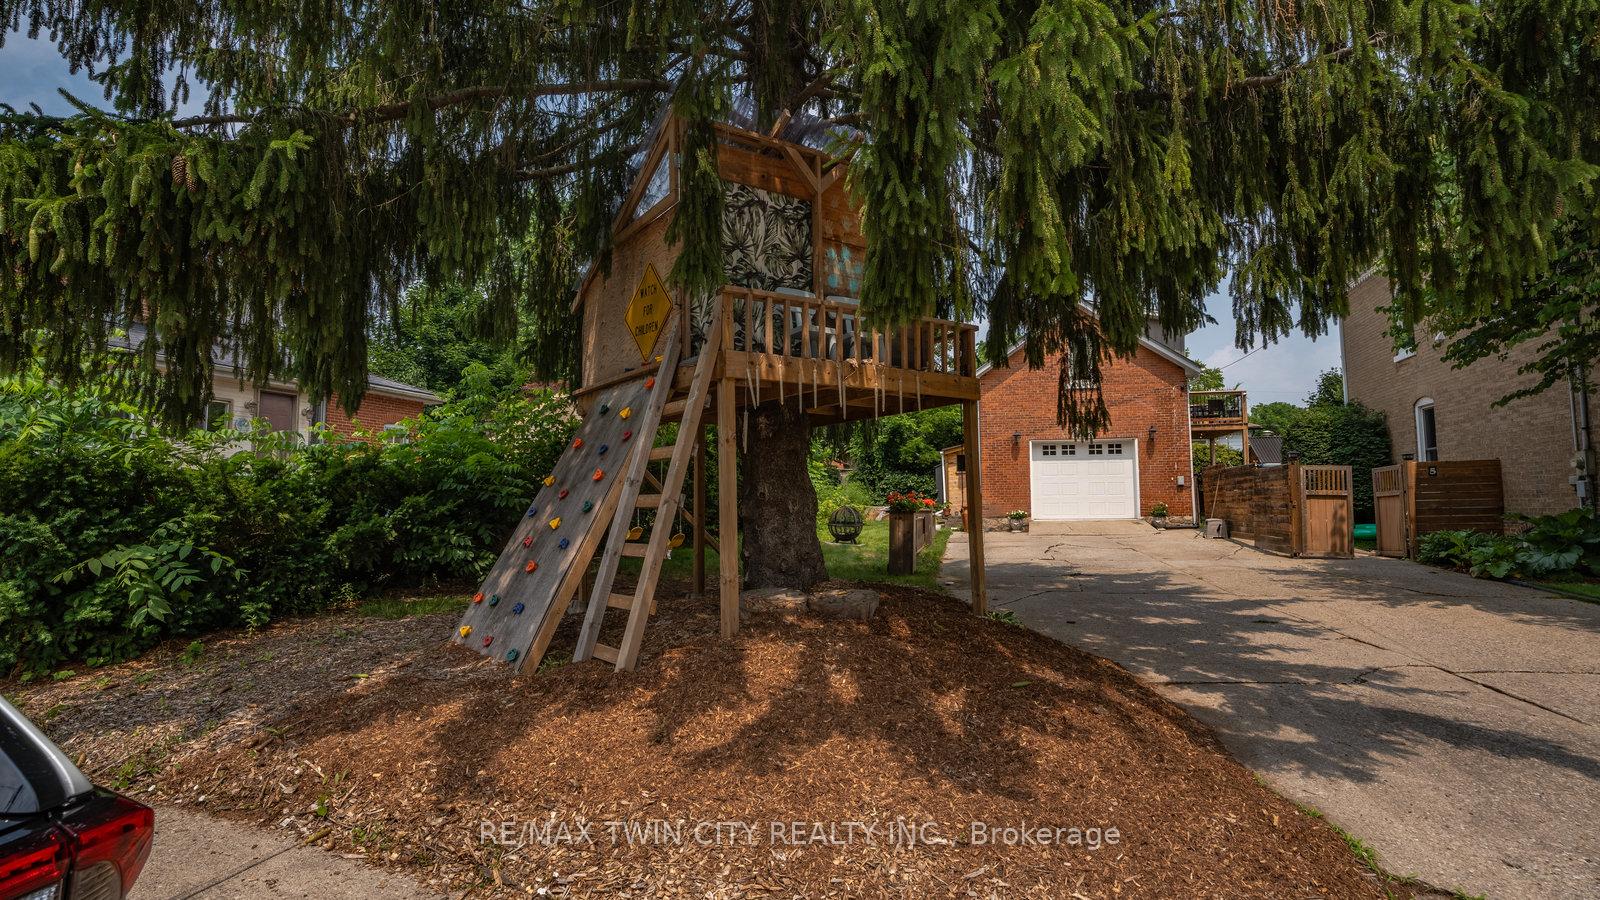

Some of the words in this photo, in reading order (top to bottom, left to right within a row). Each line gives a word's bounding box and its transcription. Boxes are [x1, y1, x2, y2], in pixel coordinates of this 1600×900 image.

[640, 284, 658, 299] WATCH
[643, 303, 653, 316] FOR
[635, 320, 659, 337] CHILDREN
[1429, 467, 1437, 475] 5
